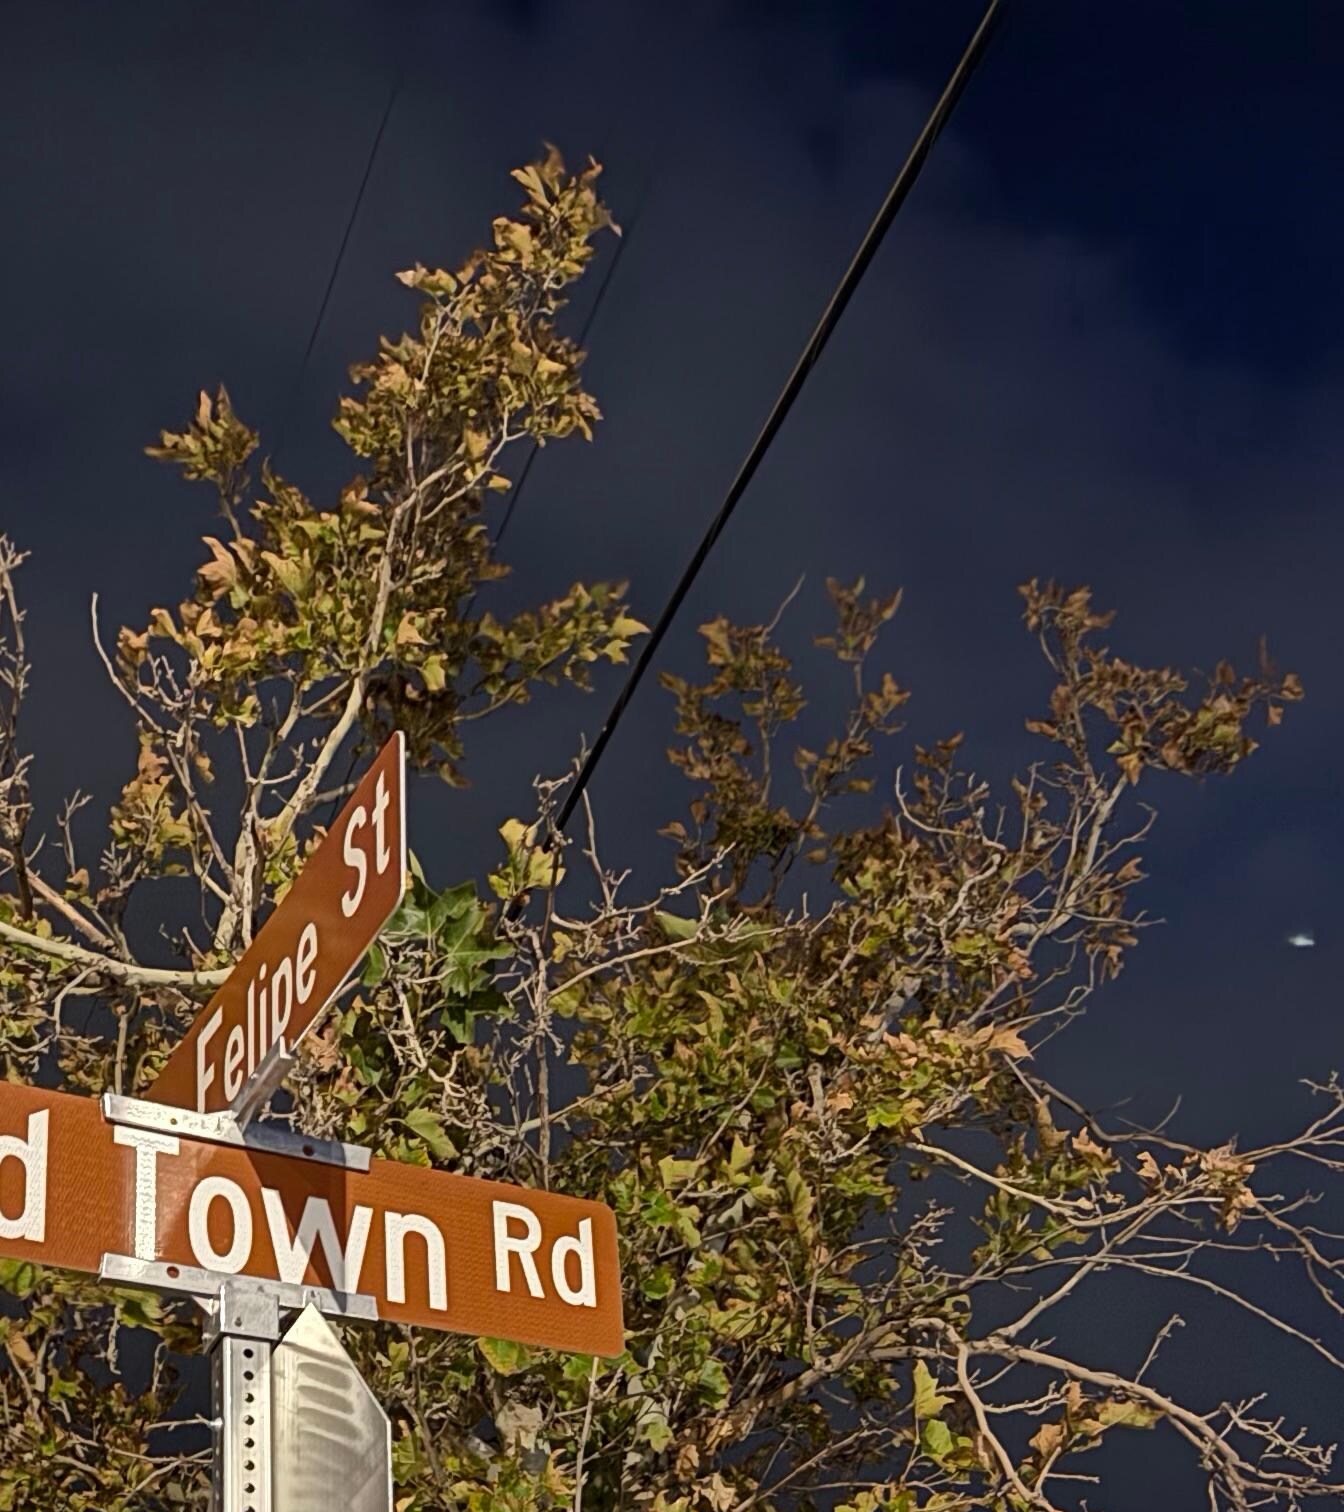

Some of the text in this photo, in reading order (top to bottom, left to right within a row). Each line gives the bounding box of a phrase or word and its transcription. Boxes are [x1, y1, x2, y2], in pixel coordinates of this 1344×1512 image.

[197, 770, 392, 1114] Felipe St
[113, 1125, 448, 1312] Town
[492, 1200, 598, 1309] Rd
